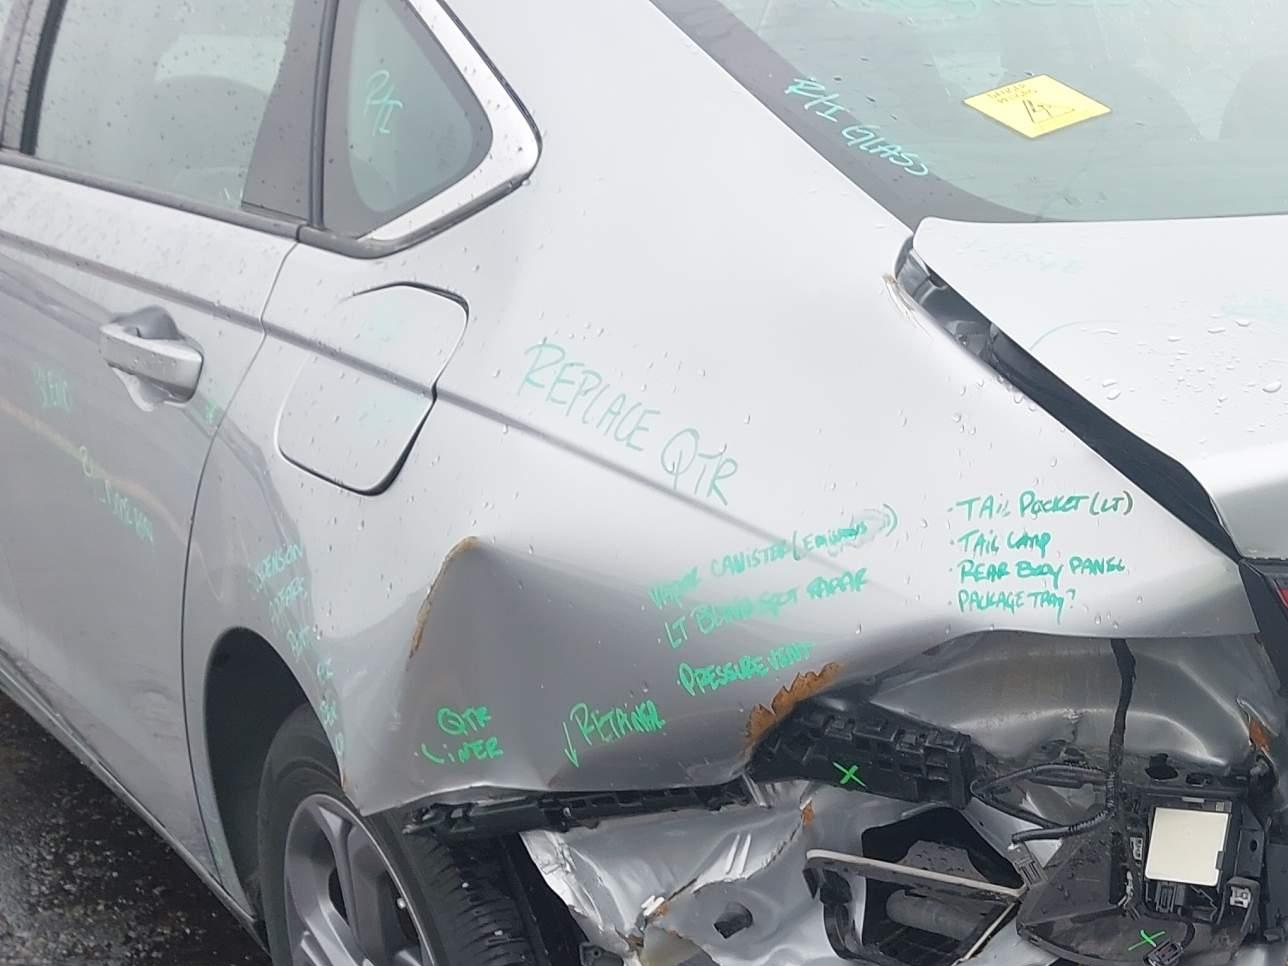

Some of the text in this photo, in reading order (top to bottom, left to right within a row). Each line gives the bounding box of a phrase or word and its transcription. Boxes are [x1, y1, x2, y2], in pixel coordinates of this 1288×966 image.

[842, 124, 929, 175] GLASS
[517, 343, 738, 506] REPLACE QTR
[958, 559, 1010, 583] REAR
[1069, 556, 1126, 575] PANEL
[664, 616, 688, 648] LT
